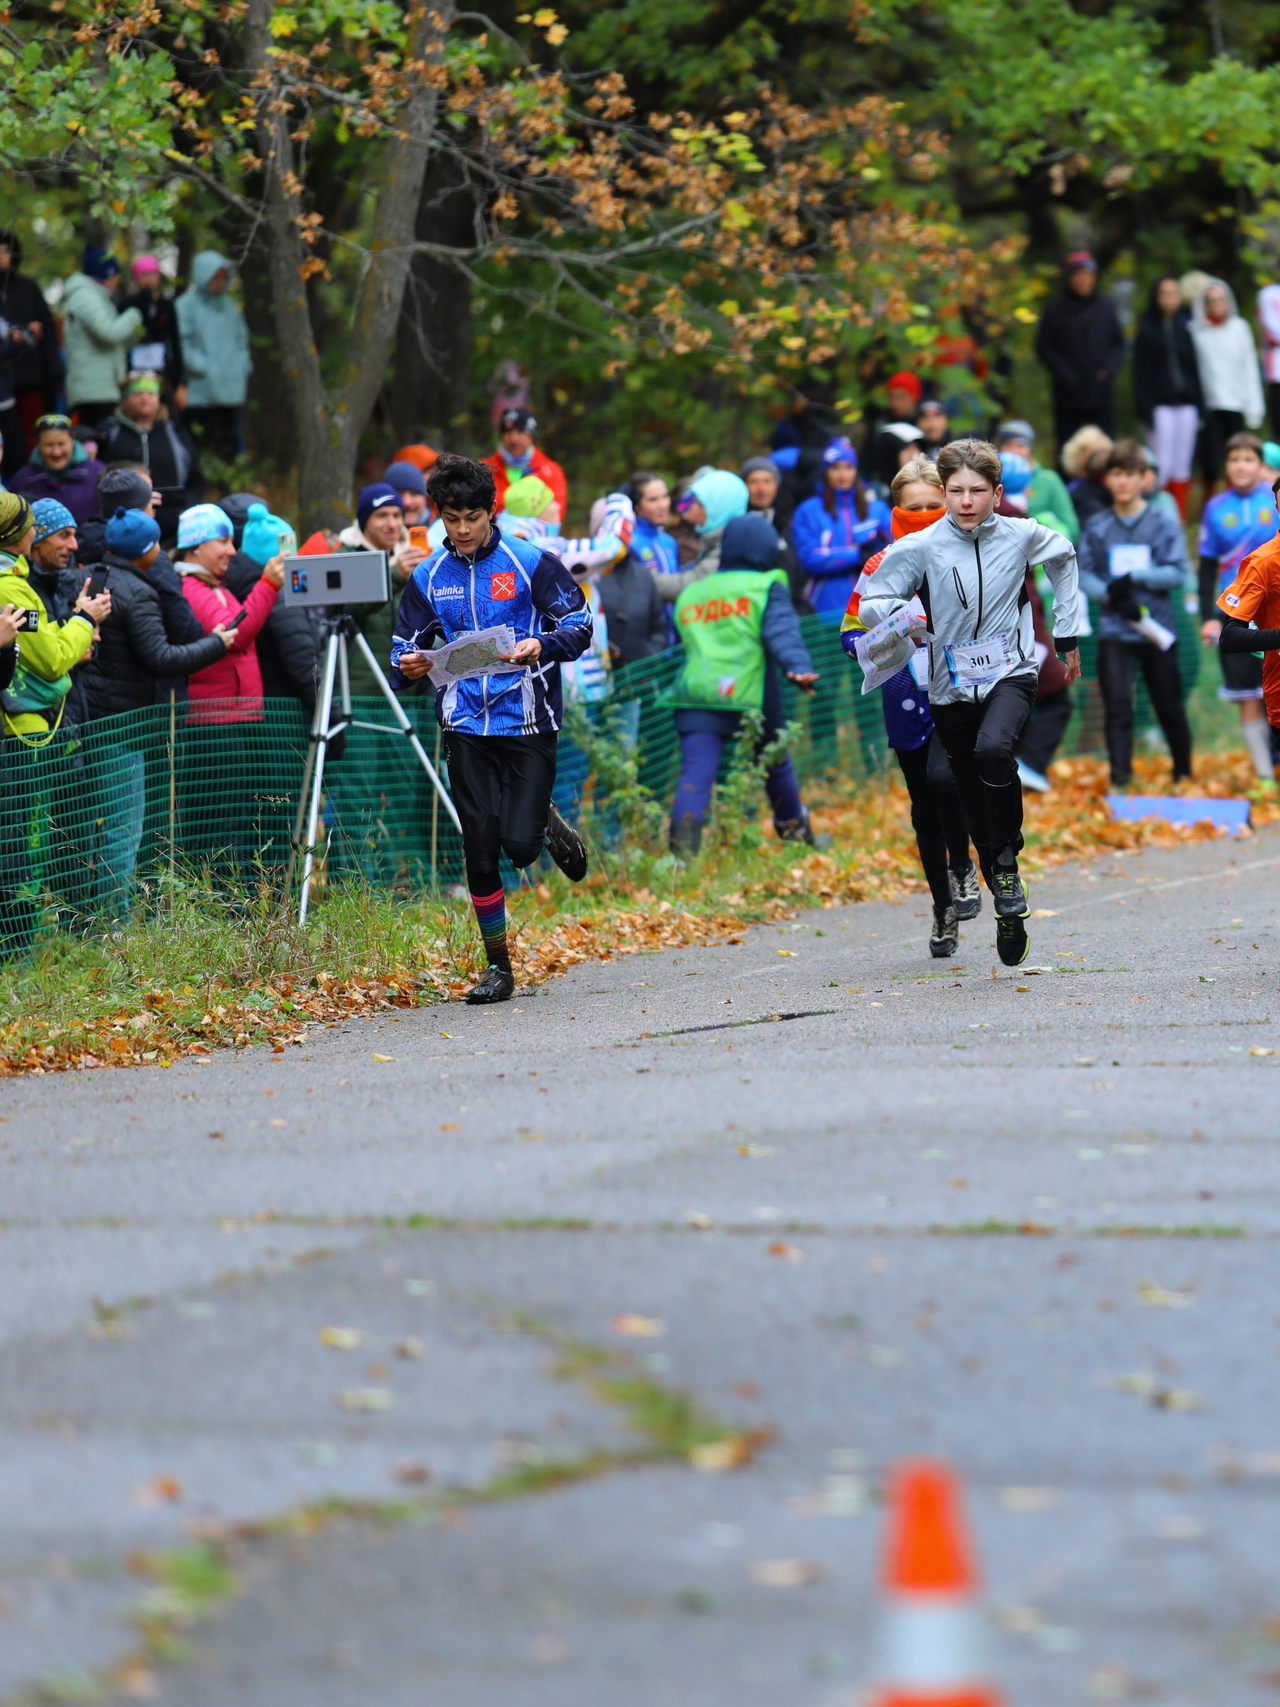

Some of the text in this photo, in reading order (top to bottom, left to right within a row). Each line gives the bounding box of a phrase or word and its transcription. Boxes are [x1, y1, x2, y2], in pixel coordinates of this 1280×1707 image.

[432, 584, 465, 597] kalinka
[681, 596, 750, 625] СУДЬЯ
[969, 654, 991, 669] 301
